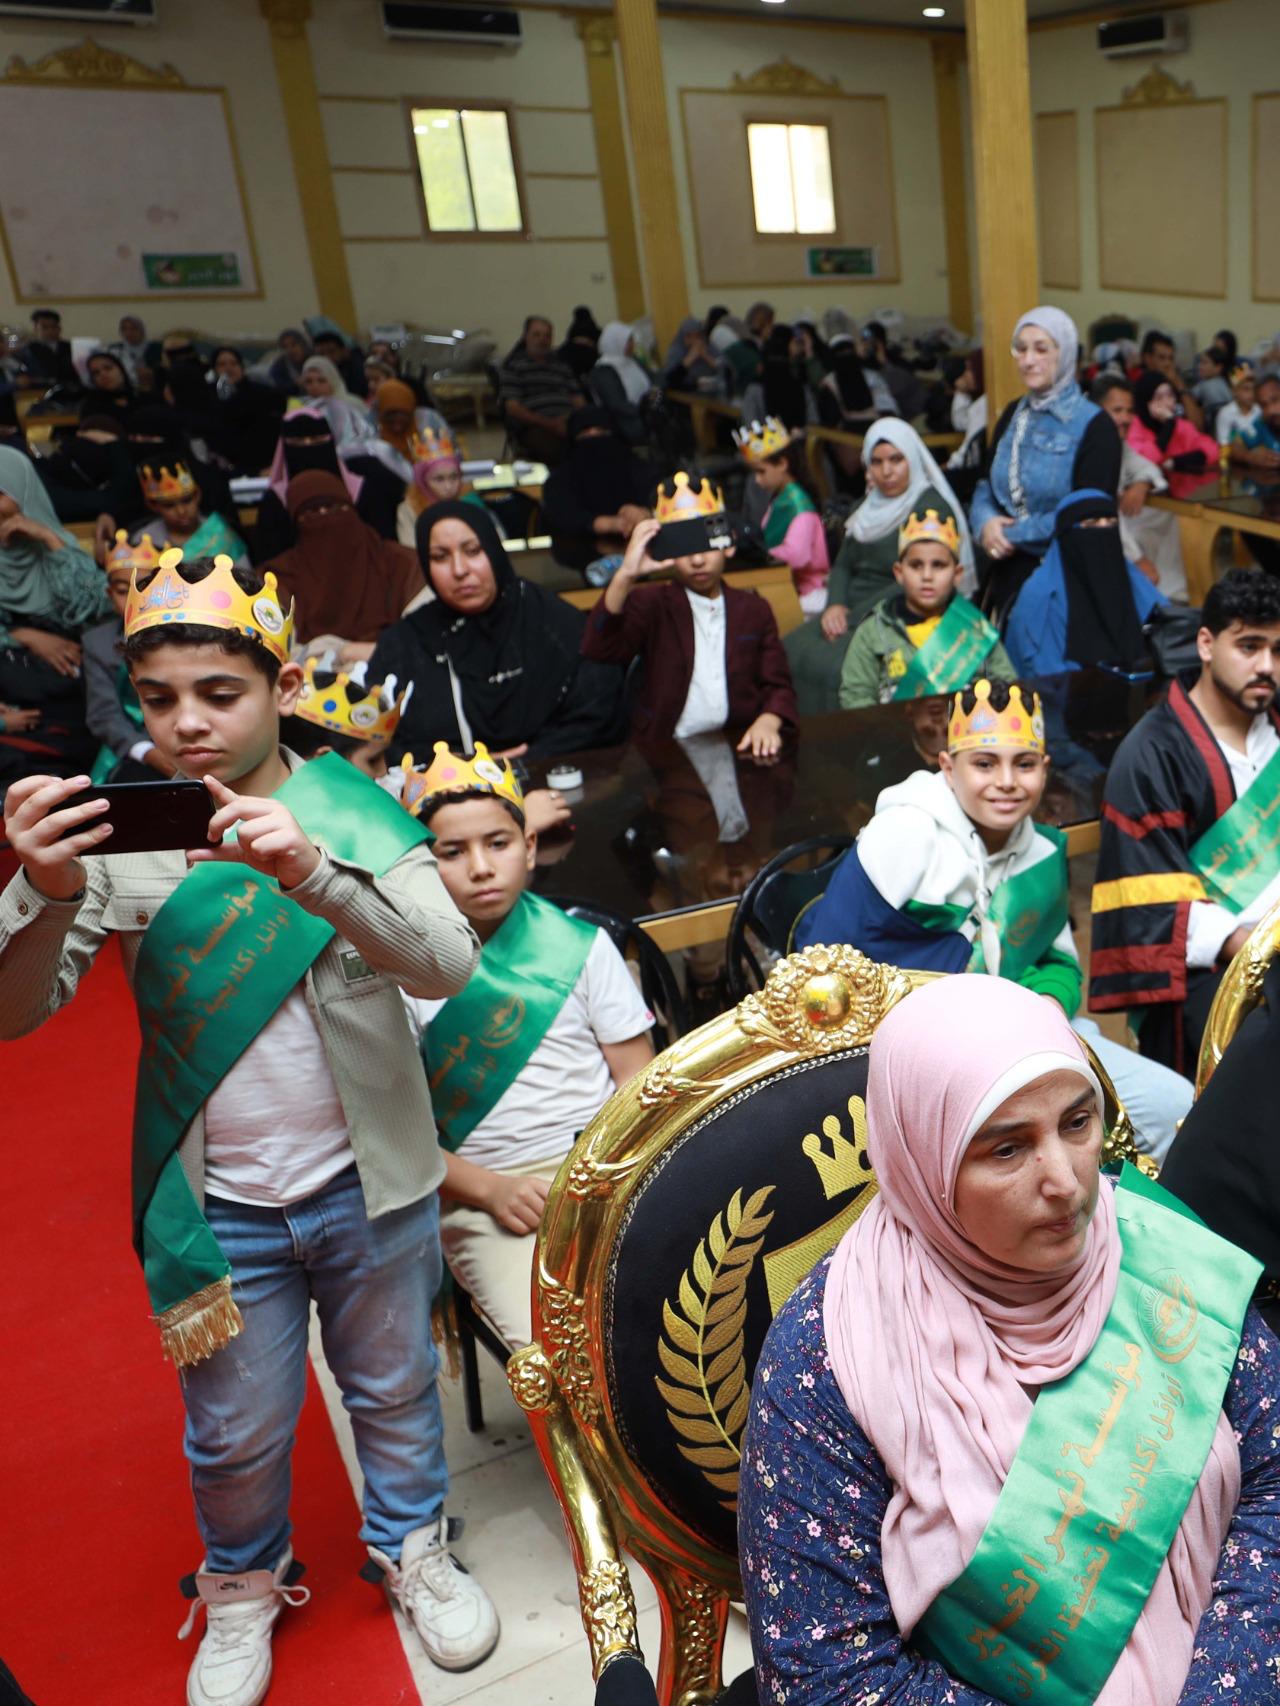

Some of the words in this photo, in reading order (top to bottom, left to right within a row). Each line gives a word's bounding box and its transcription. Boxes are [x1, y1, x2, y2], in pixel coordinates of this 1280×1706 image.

[175, 879, 260, 964] مؤسسة
[1060, 1343, 1142, 1468] مؤسسة
[1044, 1468, 1086, 1564] نهر
[966, 1552, 1048, 1661] الخير
[1057, 1545, 1110, 1631] تحفيظ
